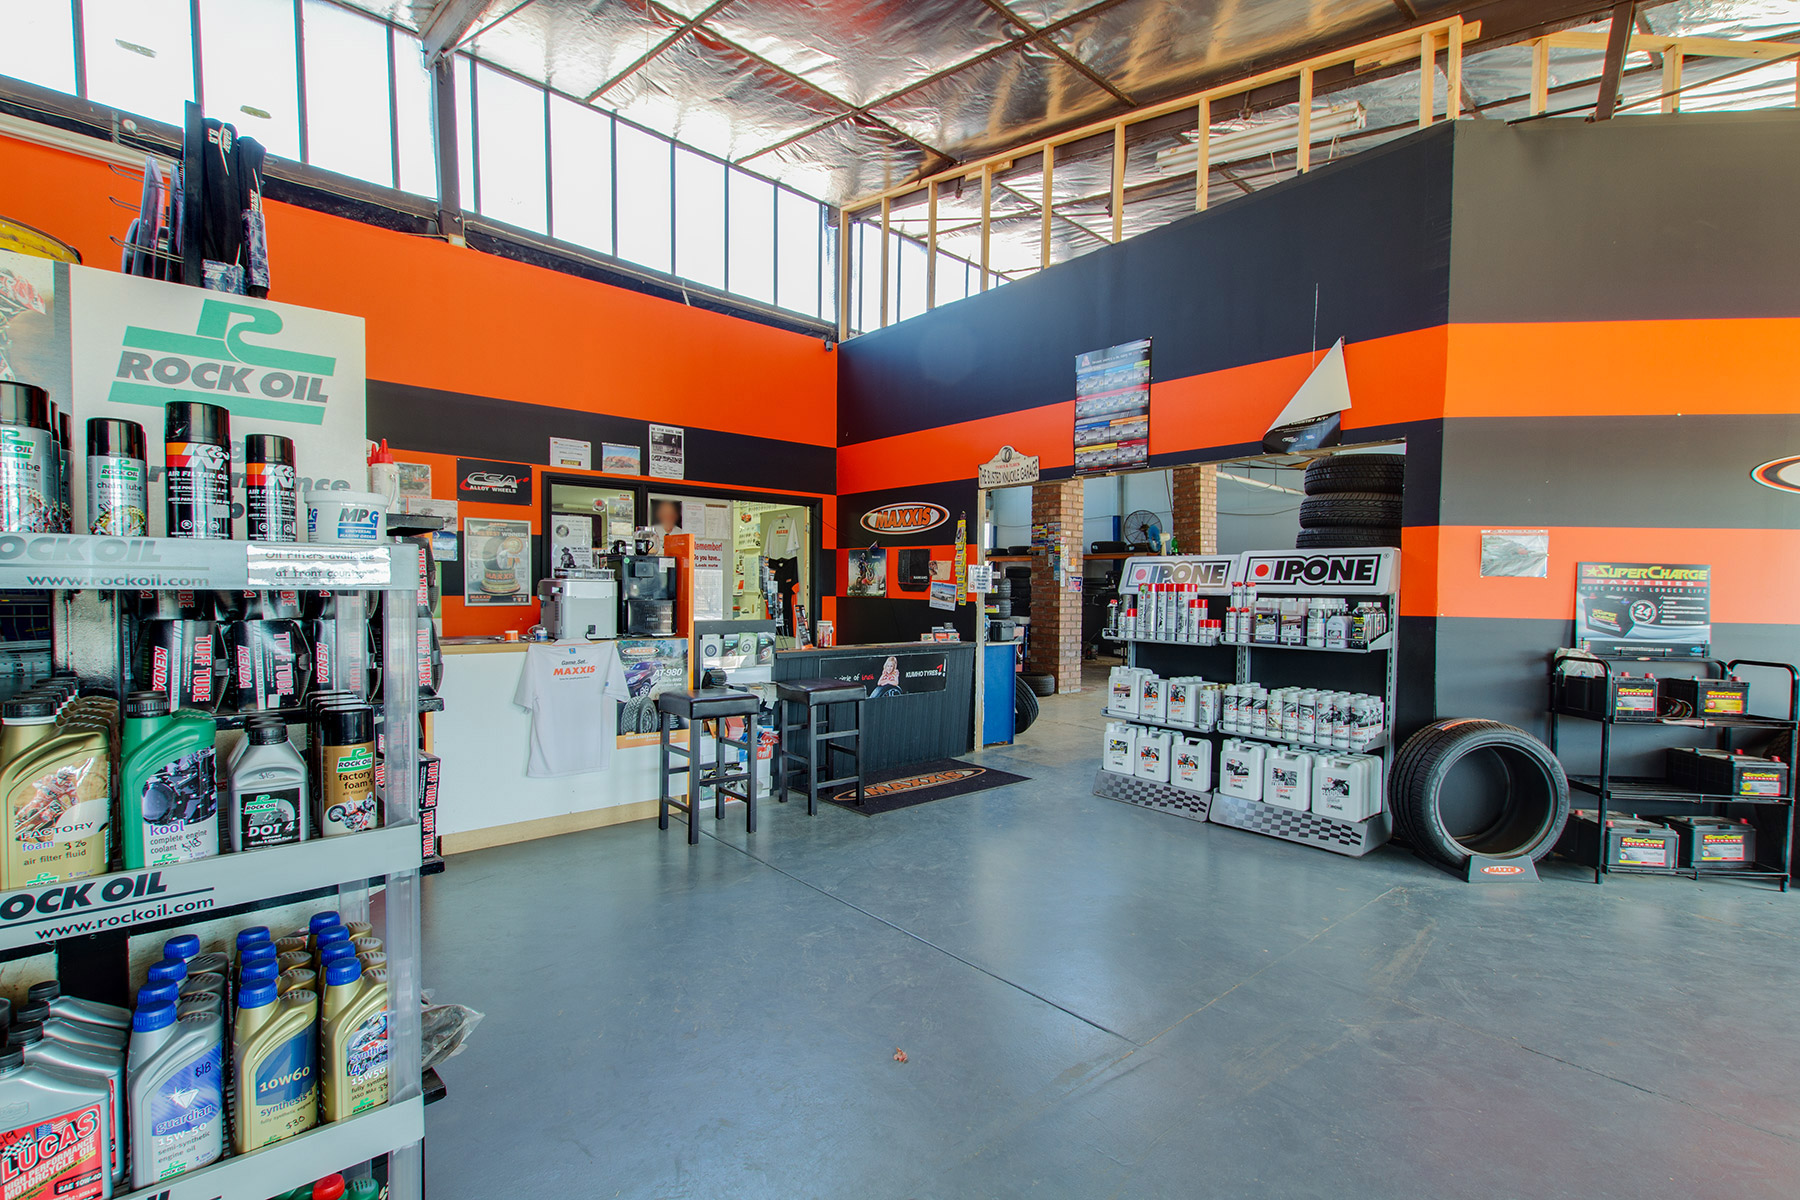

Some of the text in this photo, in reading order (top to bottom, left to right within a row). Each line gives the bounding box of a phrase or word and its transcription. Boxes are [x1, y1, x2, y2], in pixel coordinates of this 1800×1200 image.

[116, 350, 329, 404] ROCK OIL
[14, 445, 33, 454] OIL
[182, 444, 230, 471] K&N
[467, 472, 518, 489] CSA
[339, 508, 379, 529] MPG
[875, 507, 931, 529] MAXXIS
[0, 535, 162, 563] OCK OIL
[275, 569, 288, 577] at
[418, 548, 428, 576] TUFF
[1274, 556, 1374, 582] IPONE
[26, 574, 210, 587] www.rockoil.com
[1150, 561, 1227, 587] IPONE
[1635, 605, 1652, 617] 24
[236, 645, 253, 689] KENDA
[273, 632, 294, 696] TUFF TUBE
[316, 642, 329, 684] KENDA
[418, 628, 432, 686] TUFF TUBE
[152, 646, 169, 691] KENDA
[192, 634, 213, 703] TUFF TUBE
[553, 666, 596, 676] MAXXIS
[652, 668, 683, 677] AT-980
[338, 760, 361, 768] ROCK
[338, 771, 372, 781] factory
[344, 780, 368, 790] foam
[425, 761, 439, 808] TUFF TUBE
[864, 770, 965, 796] MAXXIS
[21, 821, 94, 839] FACTORY
[150, 820, 185, 836] kool
[150, 830, 208, 845] complete engine
[248, 822, 295, 837] DOT 4
[422, 810, 434, 857] TUFF TUBE
[22, 840, 55, 852] foam
[150, 844, 178, 854] coolant
[24, 849, 87, 866] air filter fluid
[0, 871, 168, 921] OCK OIL
[35, 898, 214, 940] www.rockoil.com
[350, 1044, 388, 1064] Synthes
[259, 1066, 311, 1093] 10W60
[350, 1064, 360, 1077] 4
[352, 1066, 386, 1086] 15W50
[352, 1084, 365, 1094] fully
[366, 1074, 388, 1088] synthet
[260, 1092, 308, 1117] synthesis
[156, 1104, 213, 1135] guardian
[286, 1115, 306, 1130] $30
[158, 1122, 208, 1146] 15W-50
[158, 1130, 211, 1155] semi-synthetic
[2, 1108, 100, 1184] LUCAS
[158, 1150, 184, 1164] engine
[4, 1175, 27, 1193] HIGH
[28, 1135, 95, 1178] PERFORMANCE
[4, 1155, 75, 1200] MOTORCYCLE
[79, 1144, 96, 1157] OIL
[58, 1172, 102, 1193] SAE 10W-40
